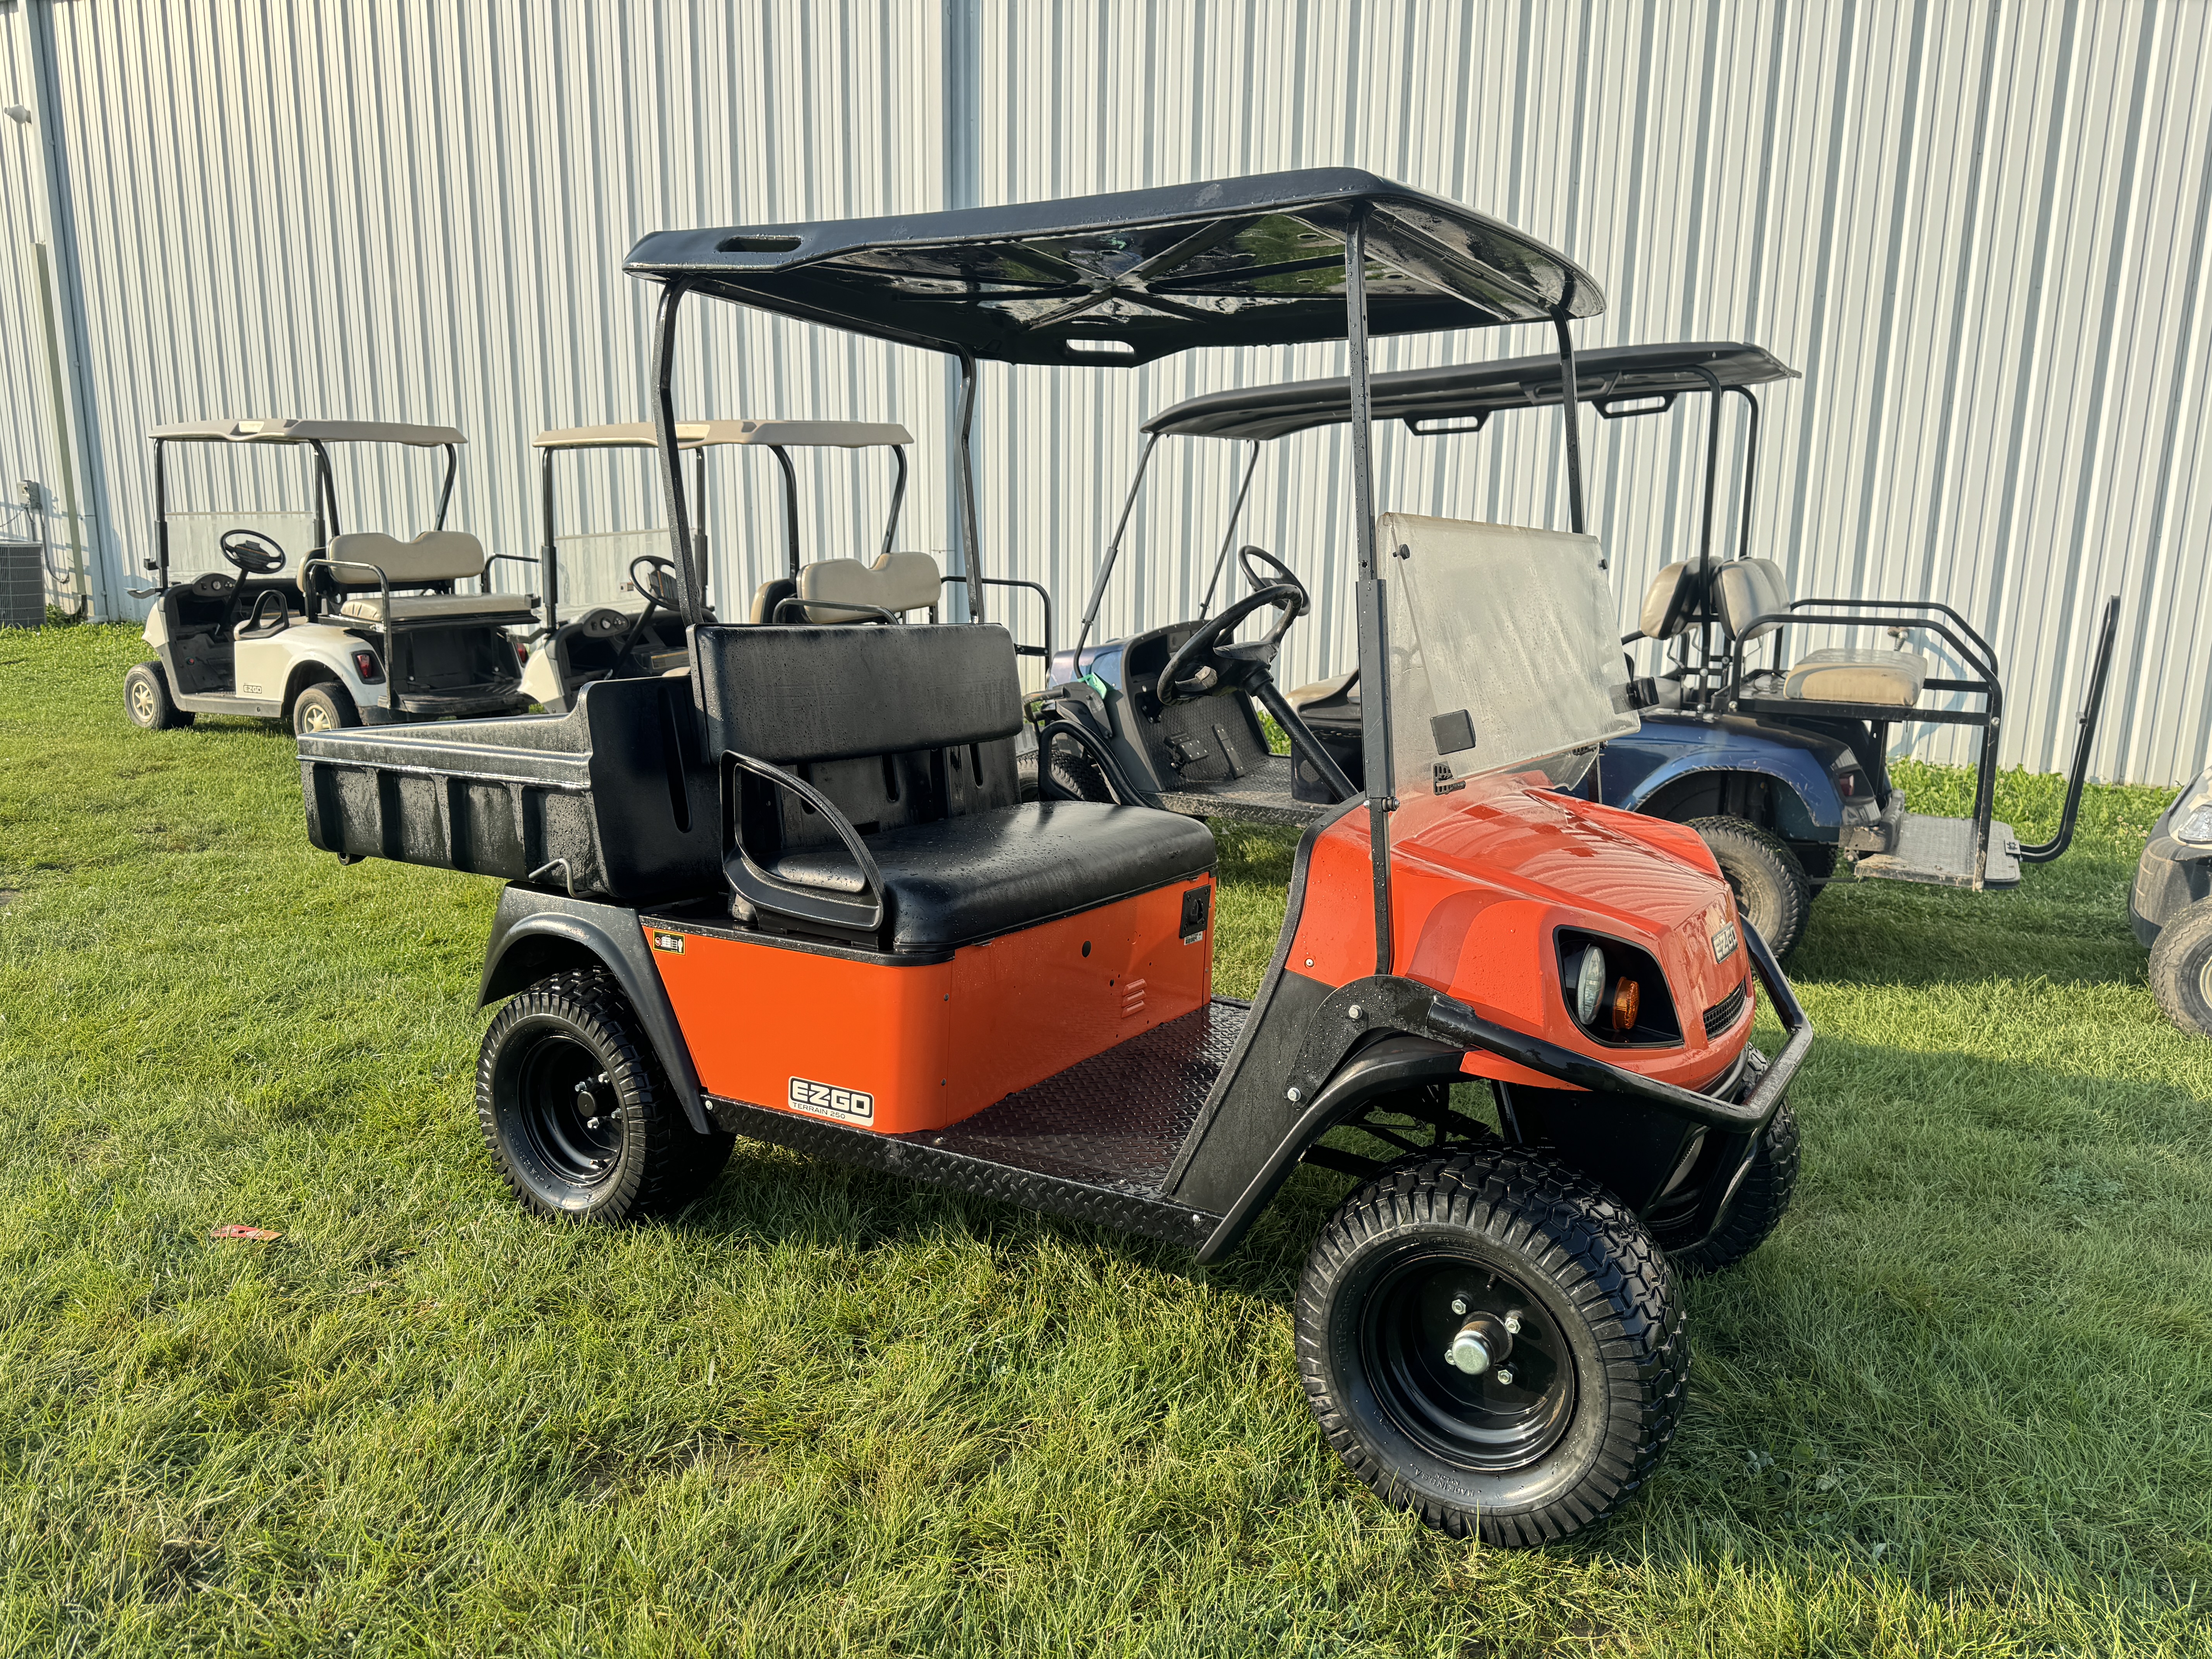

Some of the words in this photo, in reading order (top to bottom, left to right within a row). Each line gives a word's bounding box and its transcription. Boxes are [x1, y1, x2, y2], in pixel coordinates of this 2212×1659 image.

[244, 685, 262, 693] EZGO
[1713, 926, 1737, 961] EZGO
[792, 1080, 870, 1116] EZGO
[792, 1102, 828, 1115] TERRAIN
[1448, 1485, 1474, 1497] MADE
